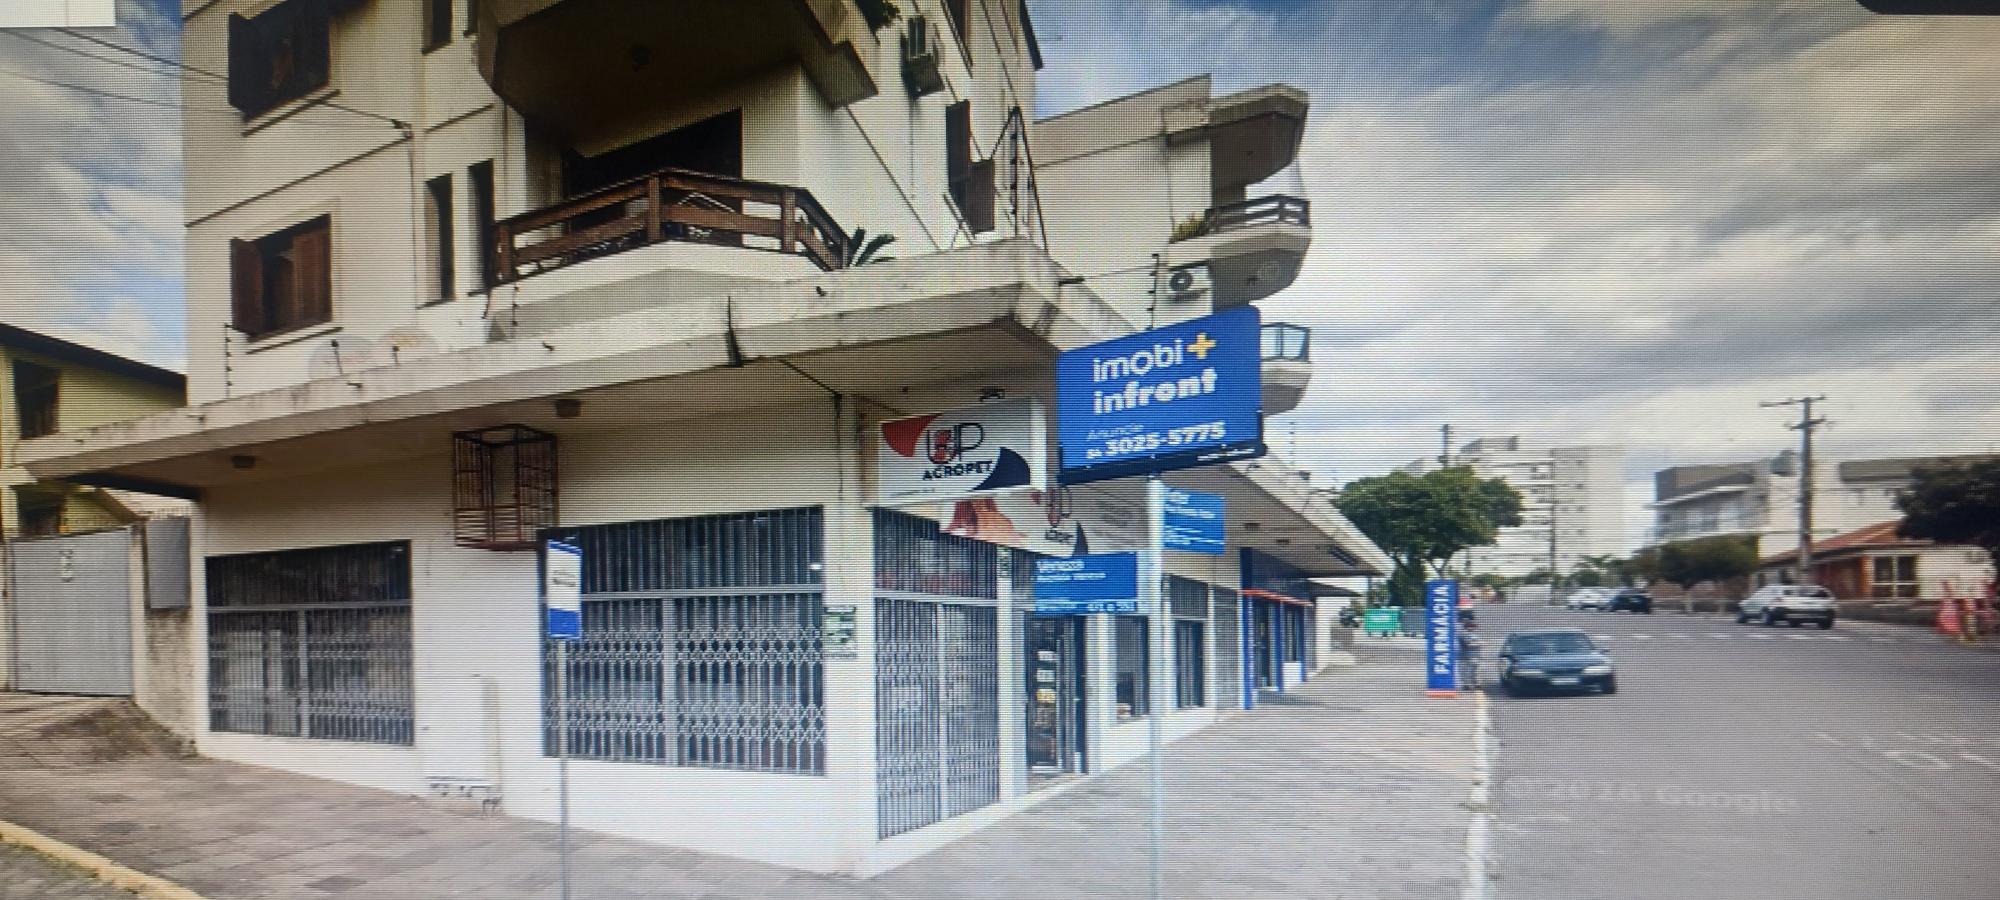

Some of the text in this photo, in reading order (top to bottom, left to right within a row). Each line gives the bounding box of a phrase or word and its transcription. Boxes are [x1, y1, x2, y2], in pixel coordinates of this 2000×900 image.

[1093, 367, 1218, 415] infront
[1087, 423, 1144, 442] Anuncie
[1105, 421, 1227, 457] 3025-5775
